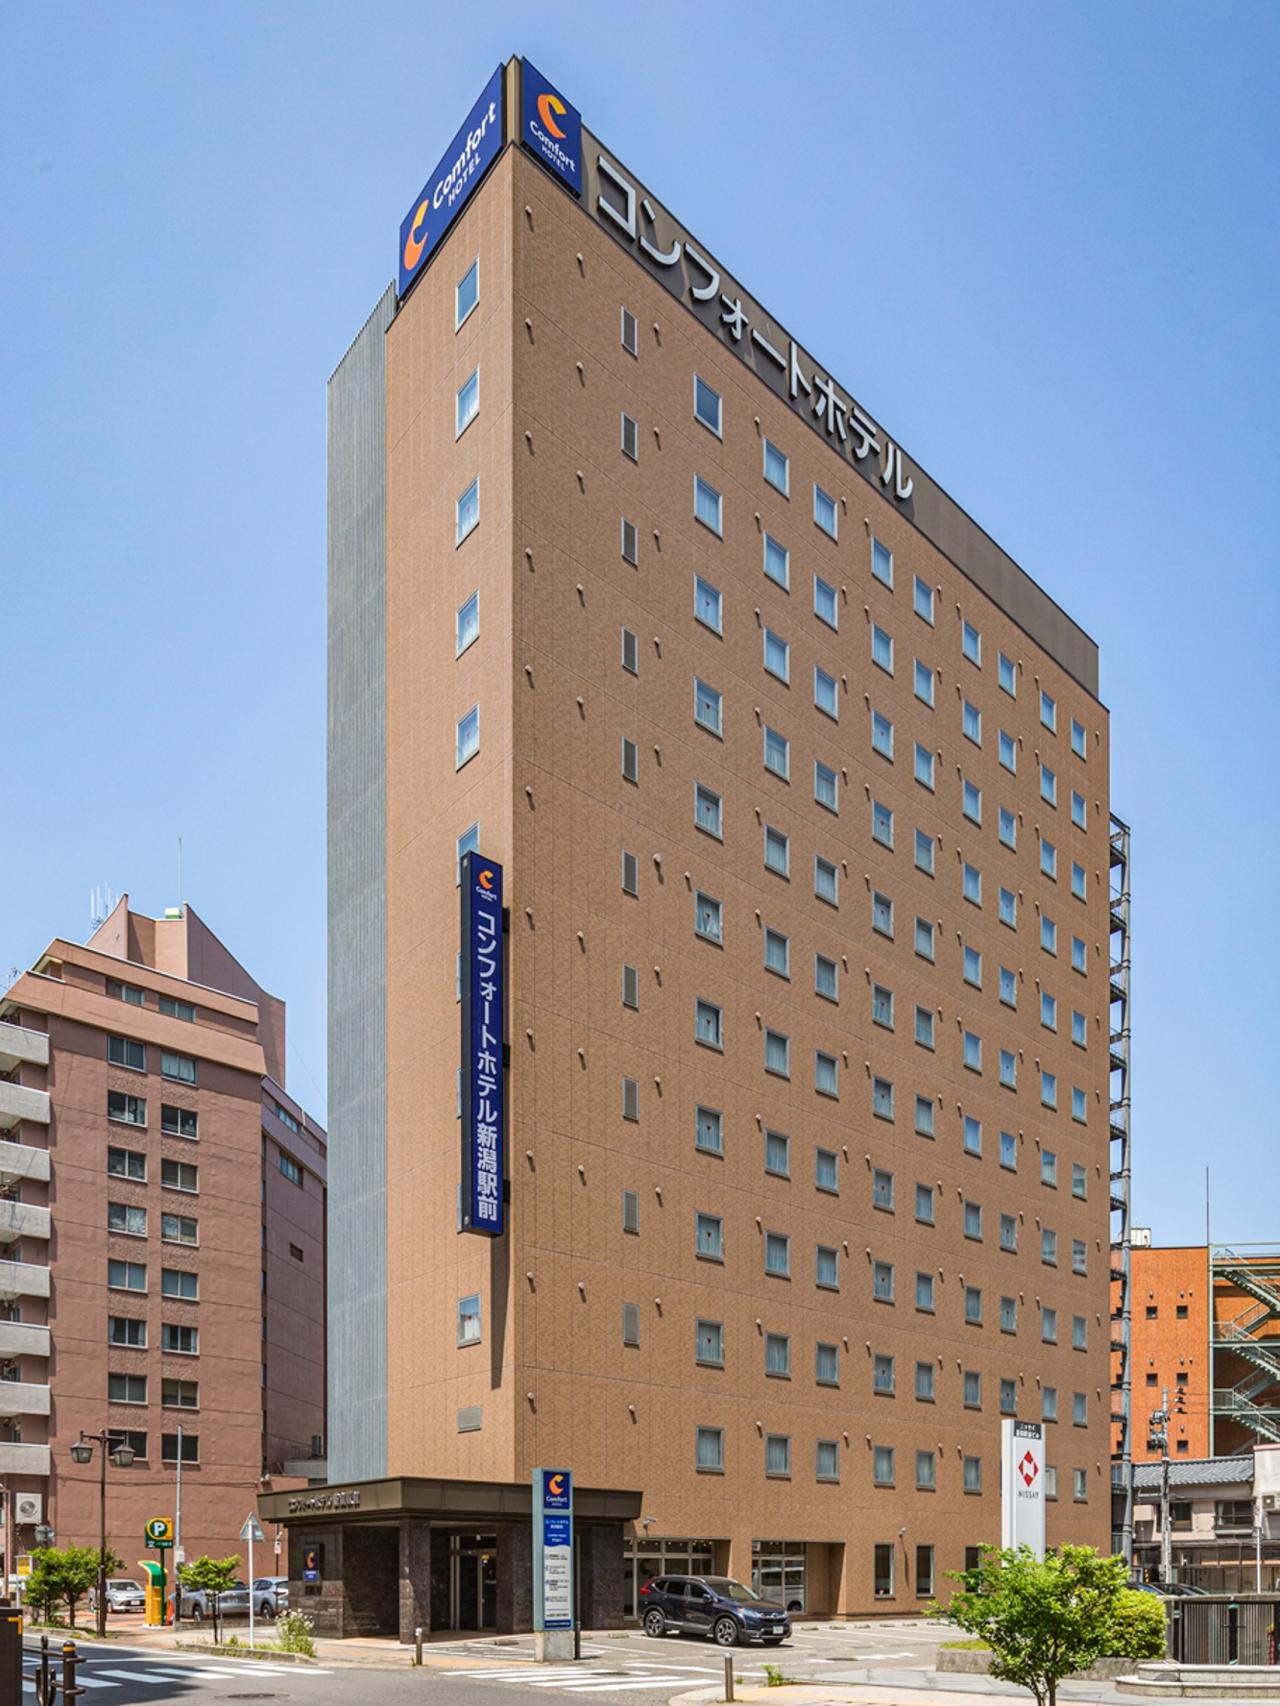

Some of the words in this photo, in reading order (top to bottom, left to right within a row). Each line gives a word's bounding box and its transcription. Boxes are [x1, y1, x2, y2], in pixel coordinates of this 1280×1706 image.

[433, 102, 496, 209] Comfort
[529, 120, 576, 173] Comfort
[541, 145, 567, 172] HOTEL
[447, 152, 482, 207] HOTEL
[597, 154, 914, 500] コンフォートホテル
[476, 909, 499, 1222] コンフォートホテル新潟駅前
[154, 1521, 165, 1536] P
